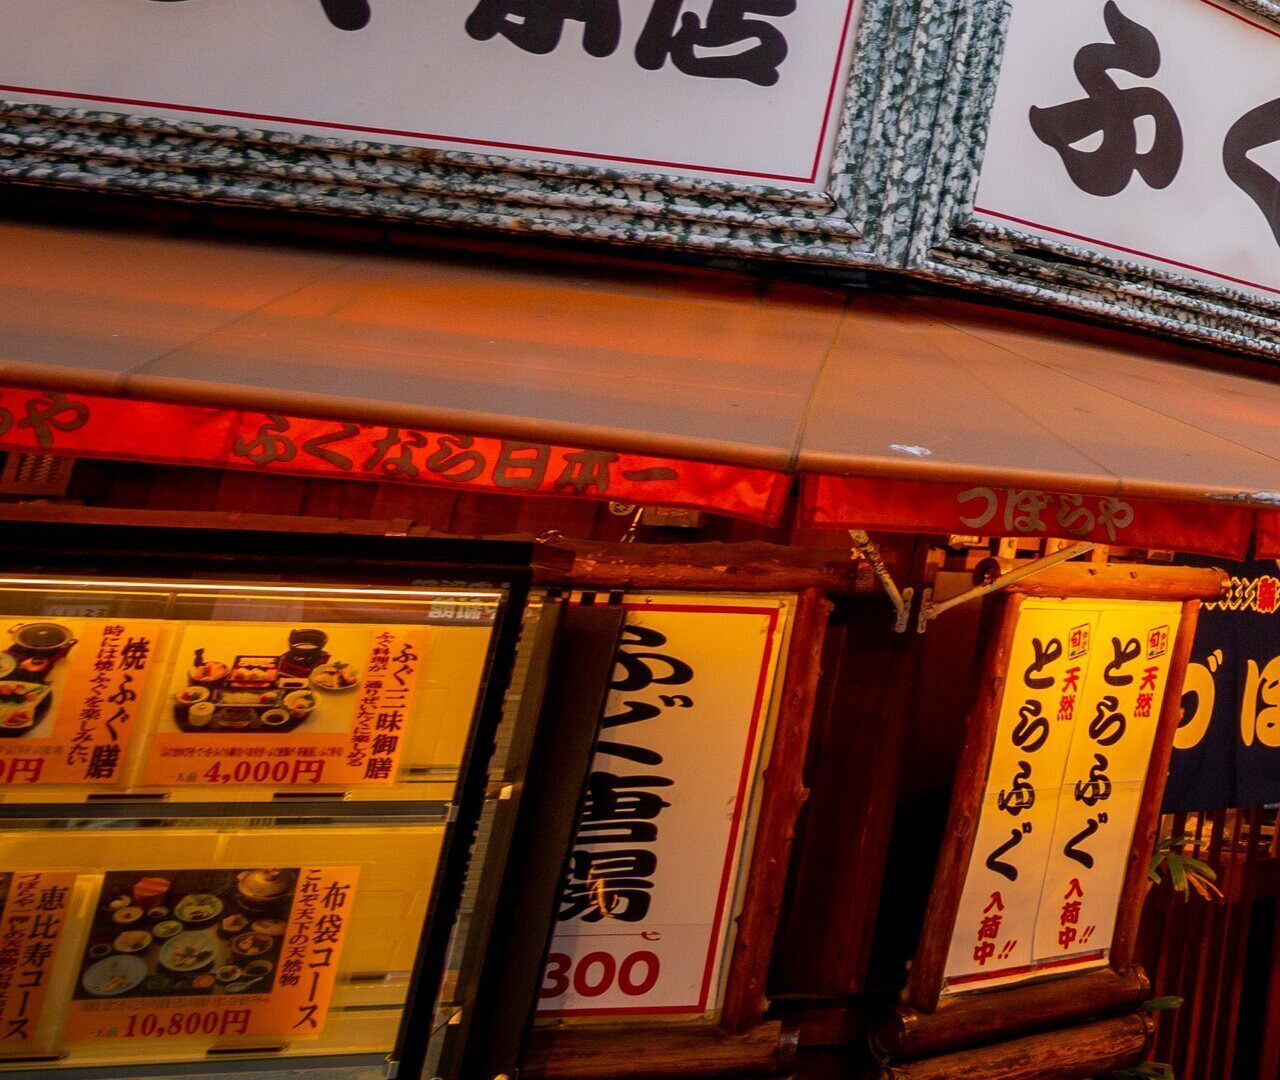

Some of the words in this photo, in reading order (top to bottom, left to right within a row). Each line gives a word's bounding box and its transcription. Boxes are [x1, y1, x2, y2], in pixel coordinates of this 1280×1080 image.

[232, 414, 680, 493] ふぐなら日本一
[85, 636, 150, 780] 焼ふぐ膳
[1056, 666, 1081, 721] 天然
[1133, 666, 1159, 719] 天然
[204, 759, 326, 784] 4,000円
[985, 637, 1063, 882] とらふぐ
[1062, 636, 1142, 870] とらふぐ
[292, 881, 350, 1030] 布袋コース
[123, 1009, 252, 1038] 10,800円
